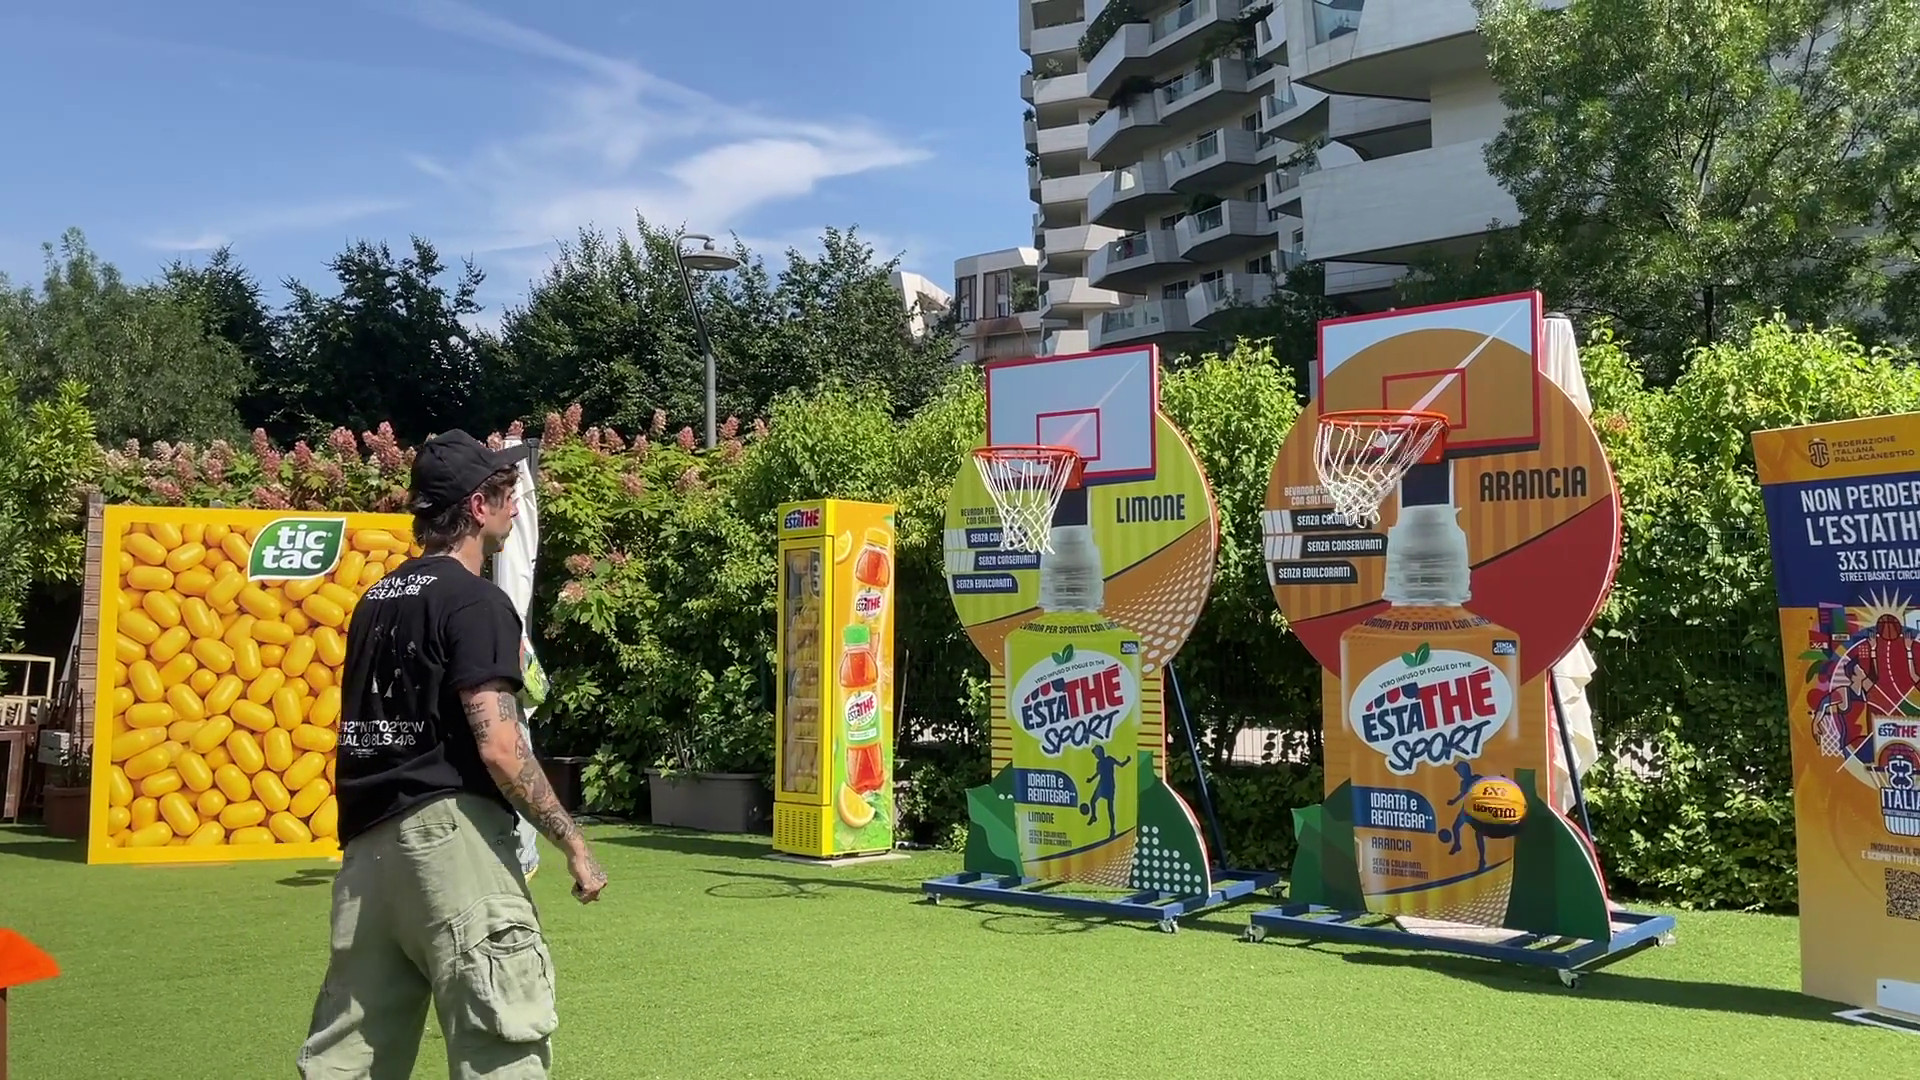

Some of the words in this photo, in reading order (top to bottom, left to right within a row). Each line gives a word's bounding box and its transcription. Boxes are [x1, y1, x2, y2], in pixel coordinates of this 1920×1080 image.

[1832, 436, 1896, 448] FEDERAZIONE
[1833, 446, 1875, 456] ITALIANA
[1835, 449, 1915, 463] PALLACANESTRO
[1480, 466, 1586, 502] ARANCIA
[1800, 486, 1842, 513] NON
[1116, 494, 1185, 523] LIMONE
[1297, 514, 1320, 526] SENZA
[1806, 510, 1920, 546] L'ESTATH
[277, 523, 327, 550] tic
[970, 533, 989, 543] SENZA
[1307, 541, 1330, 552] SENZA
[1331, 538, 1382, 551] CONSERVANTI
[261, 546, 324, 570] tac
[978, 556, 997, 566] SENZA
[997, 555, 1037, 565] CONSERVANTI
[1836, 550, 1869, 571] 3X3
[1279, 567, 1301, 579] SENZA
[1302, 566, 1350, 578] EDULCORANTI
[1839, 570, 1896, 582] STREETBASKET
[956, 579, 974, 589] SENZA
[975, 578, 1013, 589] EDULCORANTI
[1044, 625, 1058, 633] PER
[1059, 624, 1090, 634] SPORTIVI
[1091, 622, 1105, 632] CON
[1392, 620, 1409, 630] PER
[1410, 620, 1452, 631] SPORTIVI
[1453, 618, 1472, 629] CON
[1035, 675, 1047, 684] VERO
[1379, 678, 1396, 689] VERO
[1396, 671, 1418, 684] INFUSO
[1427, 664, 1449, 674] FOGLIE
[1042, 710, 1119, 755] SPORT
[1389, 720, 1491, 771] SPORT
[1027, 773, 1056, 788] IDRATA
[1057, 777, 1064, 789] e
[1370, 792, 1407, 810] IDRATA
[1410, 798, 1417, 811] e
[1028, 811, 1054, 824] LIMONE
[1371, 836, 1412, 852] ARANCIA
